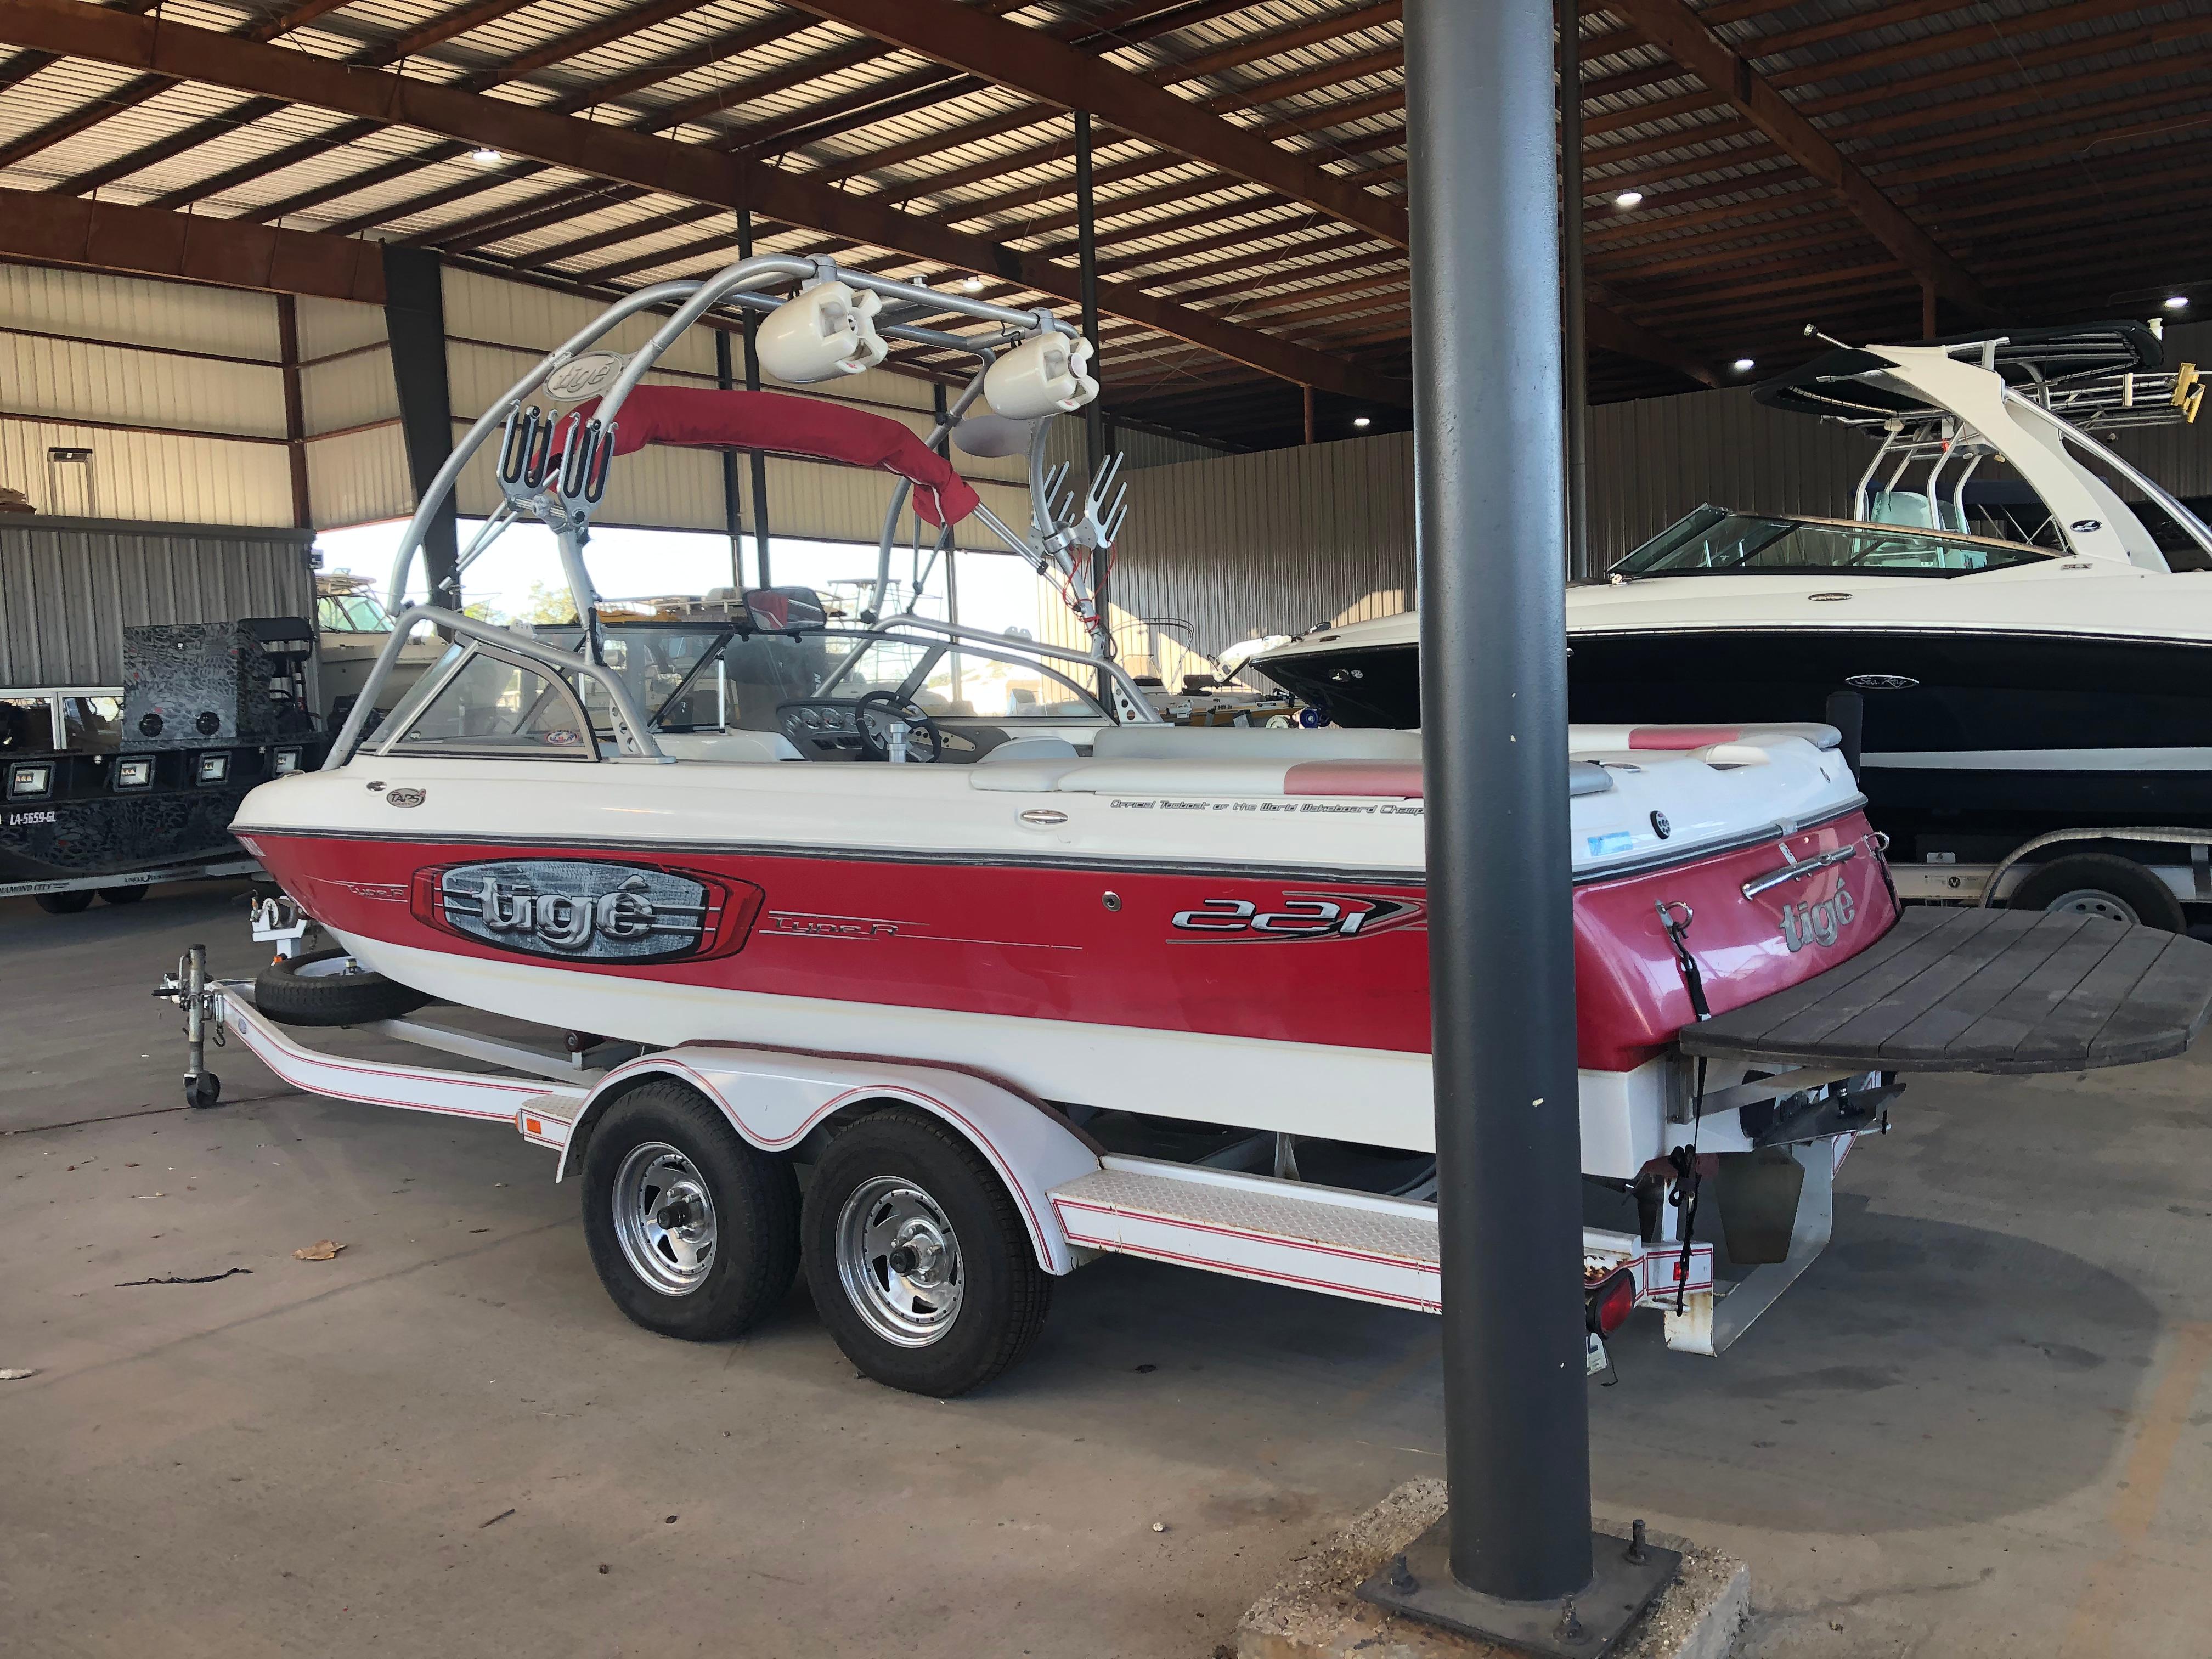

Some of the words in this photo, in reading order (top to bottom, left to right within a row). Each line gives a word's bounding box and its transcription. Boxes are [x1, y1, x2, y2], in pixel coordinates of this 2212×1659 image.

[1160, 800, 1210, 810] Towboat
[1233, 802, 1257, 811] the
[1260, 803, 1298, 812] World
[1300, 803, 1378, 813] Wakeboard
